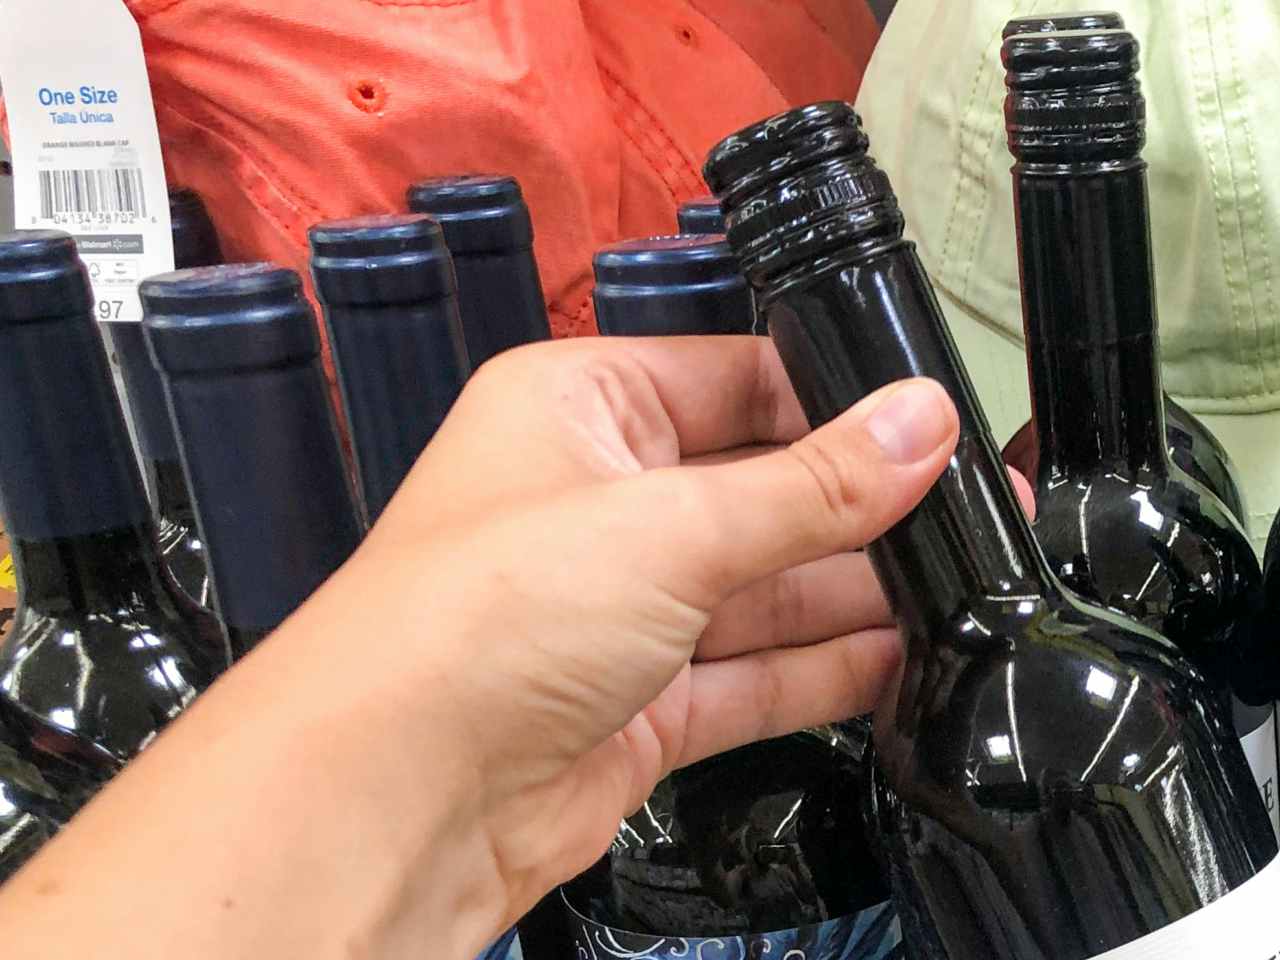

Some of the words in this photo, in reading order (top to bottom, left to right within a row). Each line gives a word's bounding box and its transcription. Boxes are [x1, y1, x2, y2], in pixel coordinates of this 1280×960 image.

[39, 87, 76, 106] One
[79, 86, 118, 105] Size
[49, 111, 78, 124] Talla
